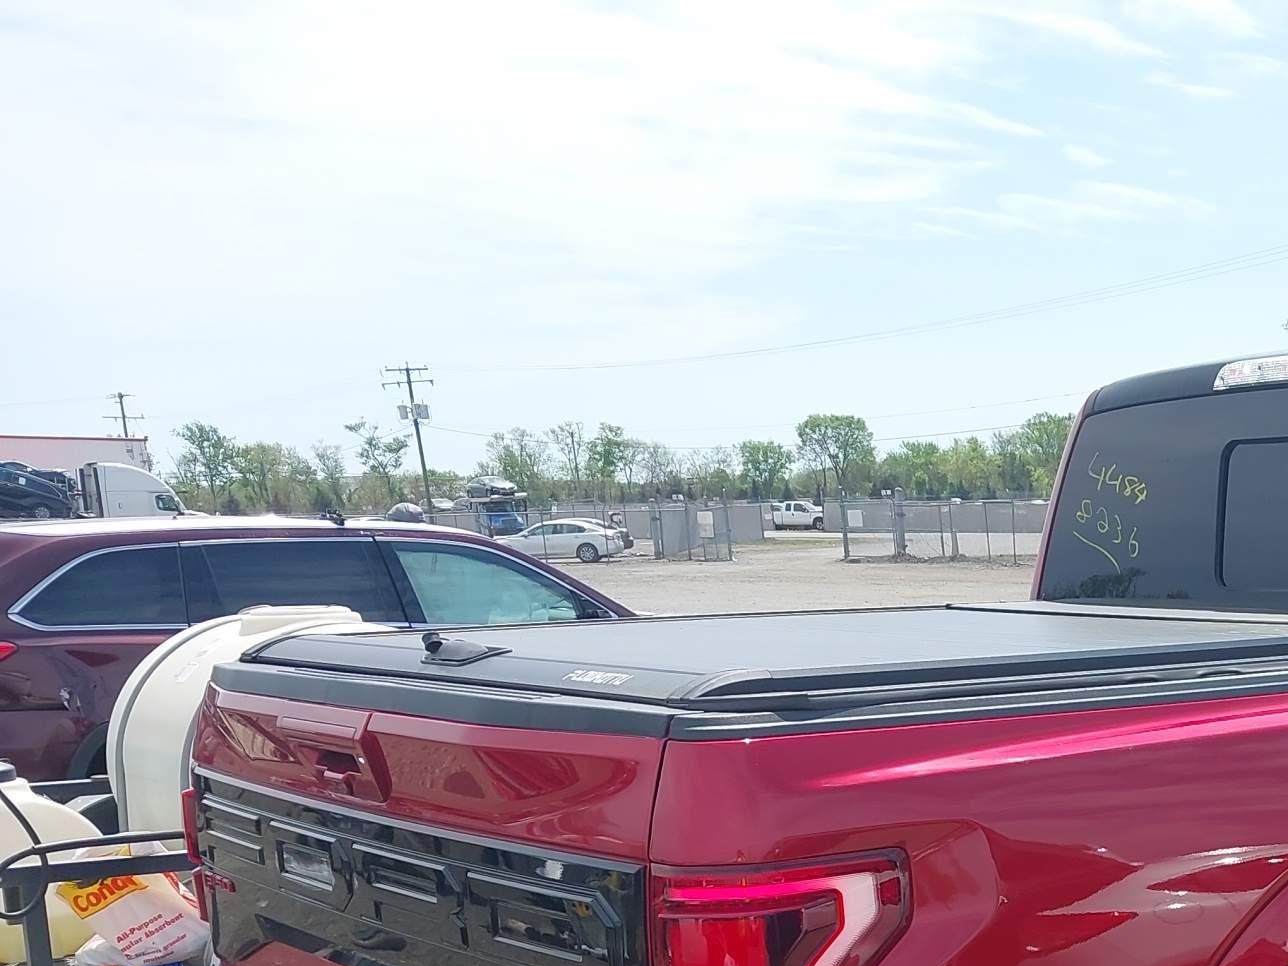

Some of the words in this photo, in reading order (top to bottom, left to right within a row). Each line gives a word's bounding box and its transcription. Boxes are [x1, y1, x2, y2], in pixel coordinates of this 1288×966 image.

[1075, 499, 1140, 558] 8236
[116, 913, 163, 943] All-Purpose
[144, 912, 184, 939] Absorbent
